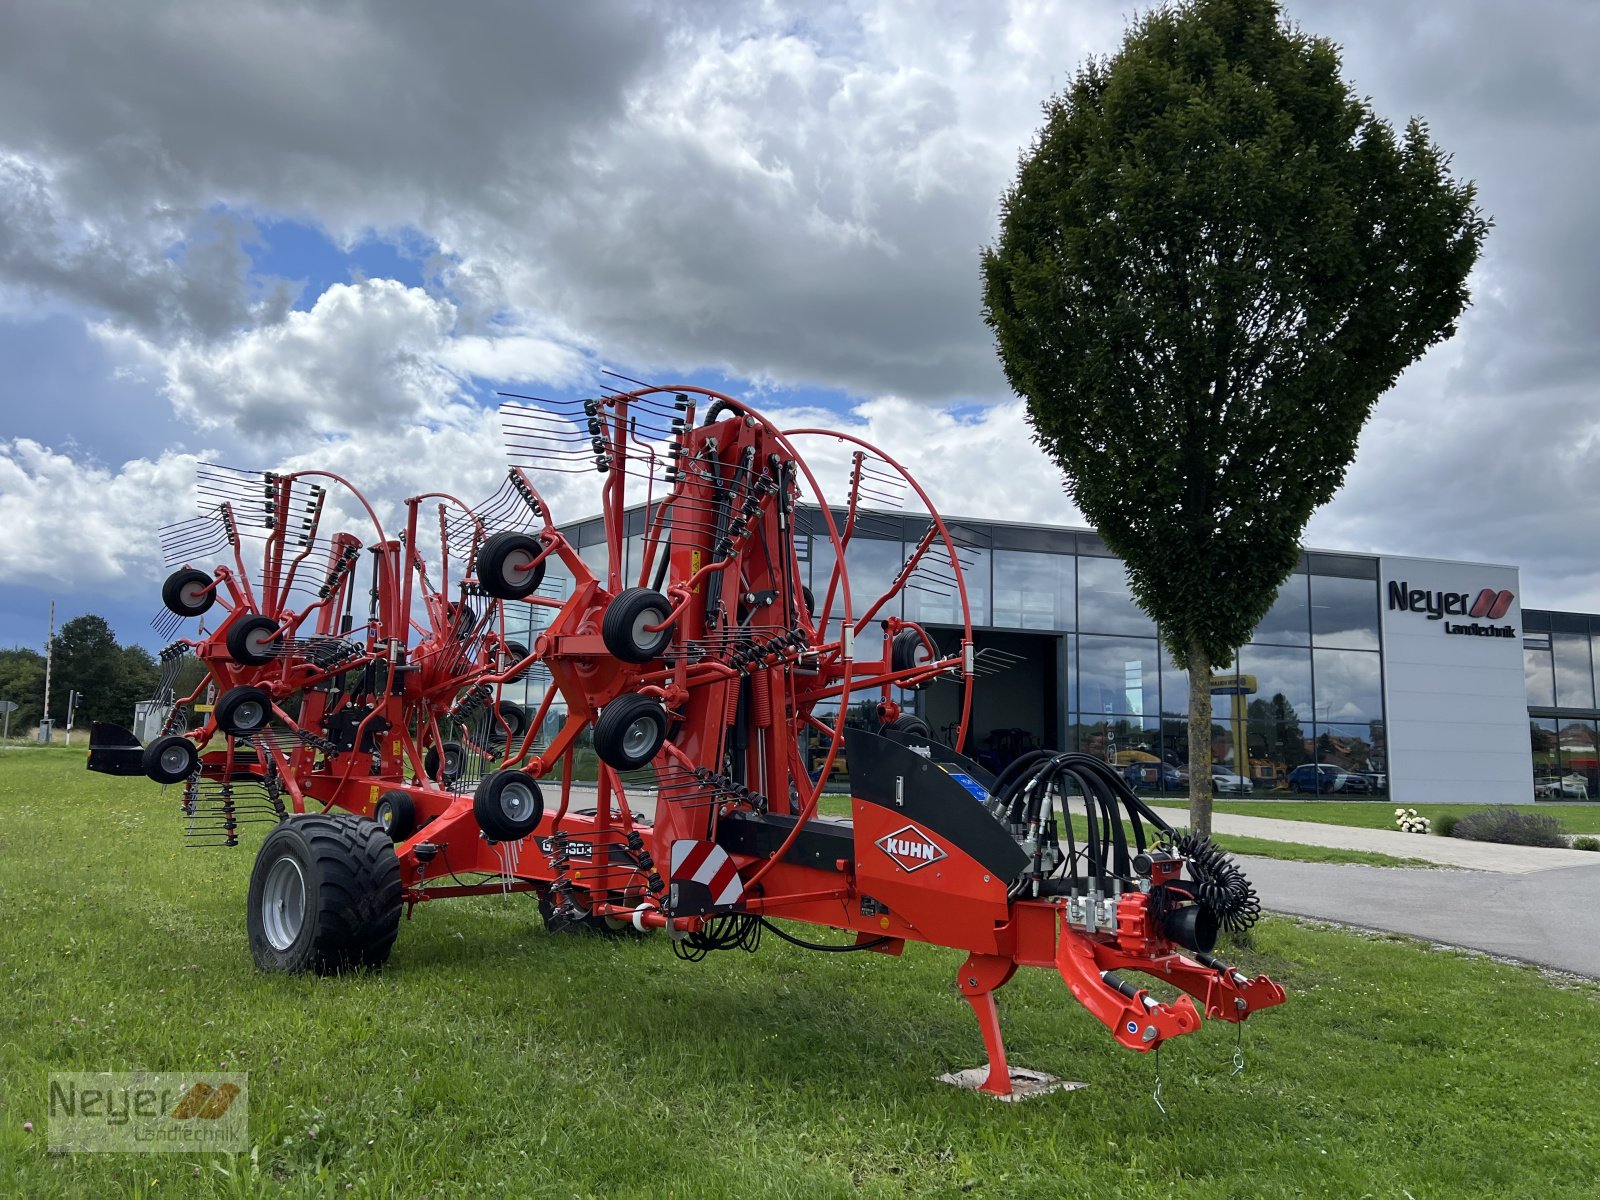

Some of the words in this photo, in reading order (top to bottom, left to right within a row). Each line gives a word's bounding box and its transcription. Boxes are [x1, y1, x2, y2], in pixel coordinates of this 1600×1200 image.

[1388, 580, 1469, 620] Neyer
[1444, 621, 1516, 638] Landtechnik
[887, 837, 934, 860] KUHN
